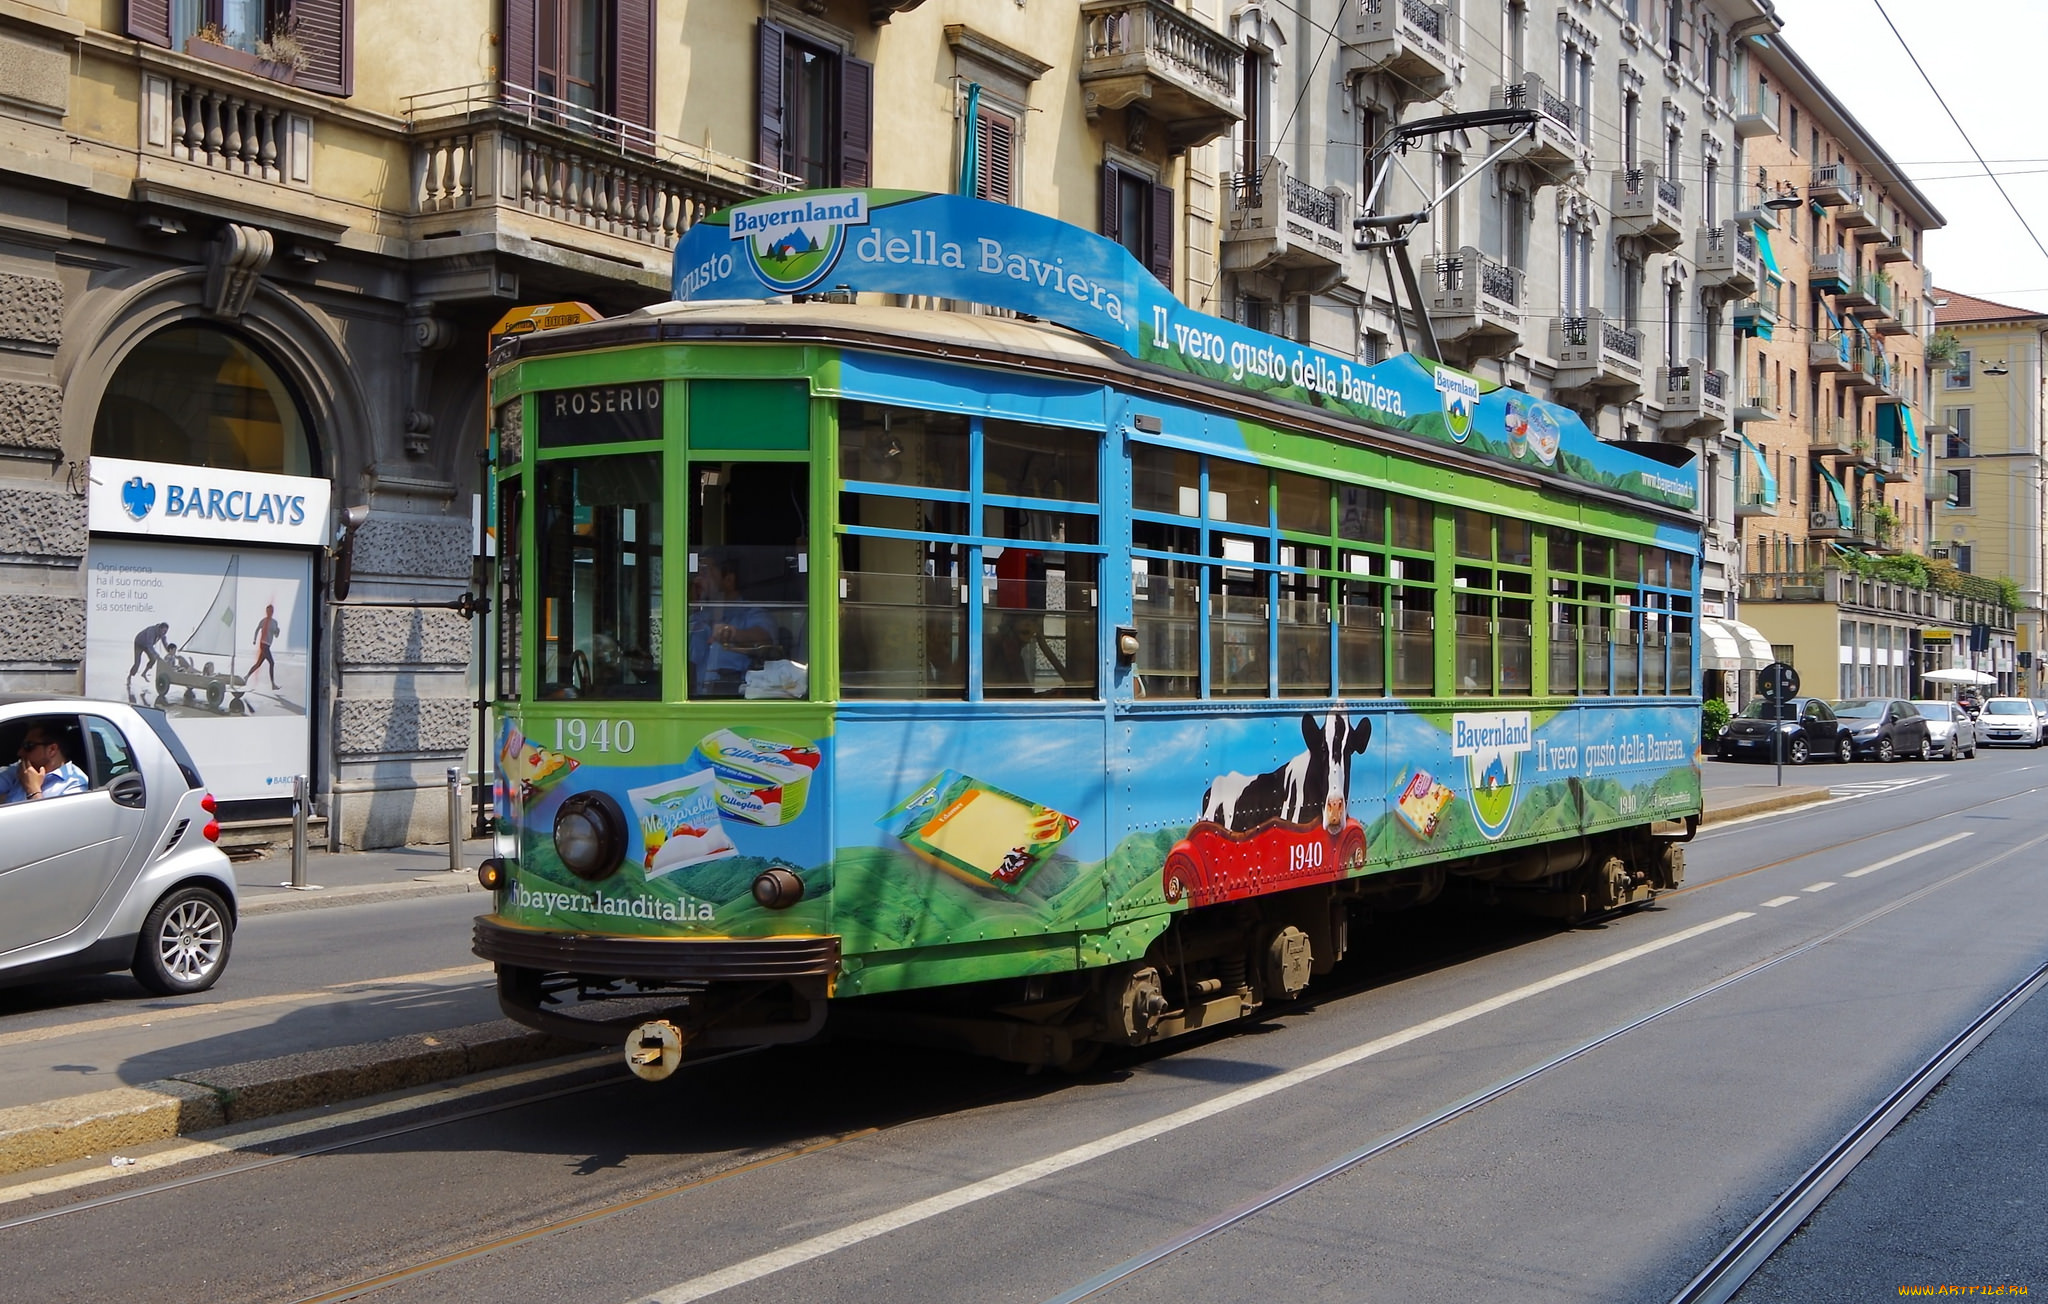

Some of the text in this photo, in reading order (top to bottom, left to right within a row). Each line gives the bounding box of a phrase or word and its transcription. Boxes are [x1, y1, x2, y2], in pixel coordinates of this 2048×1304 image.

[734, 196, 860, 233] Bayernland
[680, 227, 1131, 332] gusto della Baviera.
[1152, 304, 1407, 418] Il vero gusto della Baviera.
[1436, 370, 1478, 399] Bayernland
[554, 386, 660, 417] ROSERIO
[165, 484, 306, 526] BARCLAYS
[96, 561, 153, 576] Ogni persona
[96, 575, 165, 588] ha il suo mondo.
[95, 601, 156, 613] sia sostenibile.
[96, 588, 148, 600] Fai che il tuo
[555, 717, 636, 754] 1940
[1456, 717, 1529, 754] Bayernland
[719, 747, 795, 767] Cillegine
[1537, 732, 1686, 777] Il vero gusto della Baviera.
[273, 776, 295, 785] BARCL
[642, 795, 716, 836] Mozzarella
[720, 794, 764, 811] Cillegine
[1620, 794, 1637, 815] 1940
[1289, 841, 1323, 872] 1940
